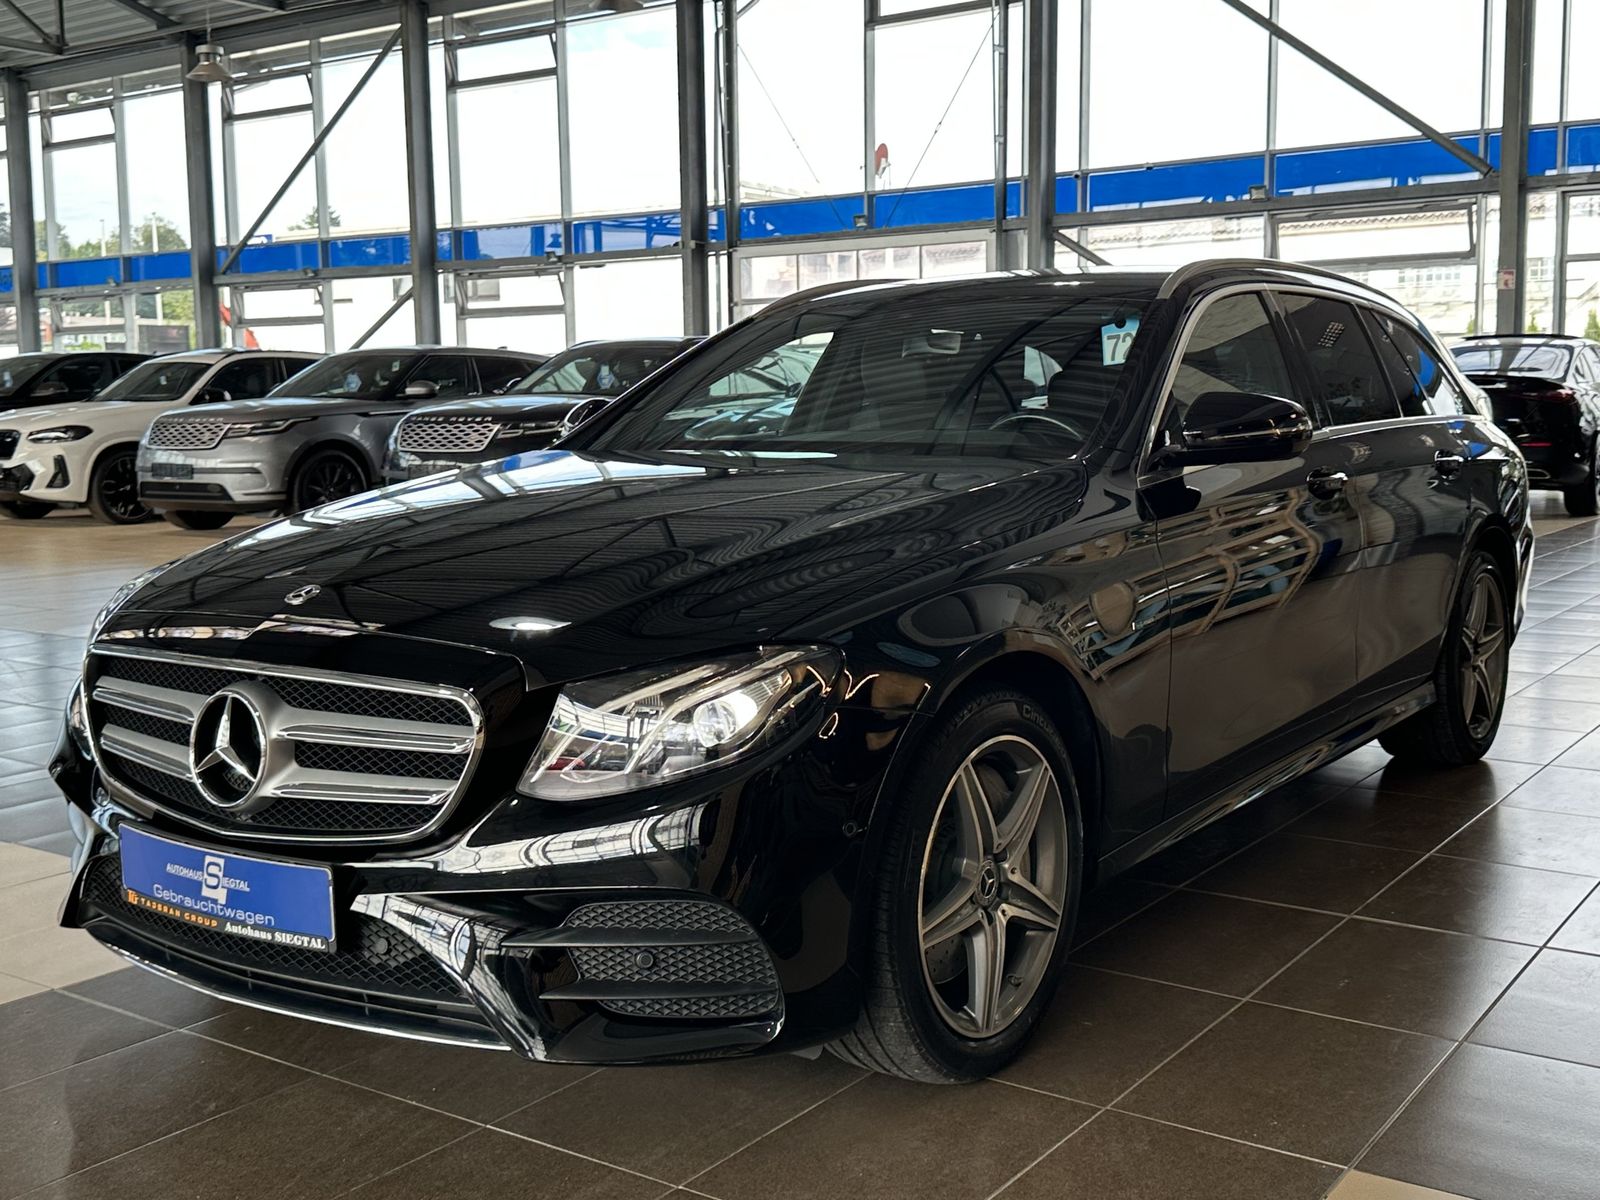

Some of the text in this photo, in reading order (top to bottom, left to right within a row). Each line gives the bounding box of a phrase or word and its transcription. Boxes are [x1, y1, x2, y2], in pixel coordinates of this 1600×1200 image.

[166, 863, 204, 880] AUTOHAUS
[153, 884, 275, 926] Gebrauchtwagen
[184, 912, 218, 928] GROUP
[224, 922, 326, 949] Autohaus SIEGTAL
